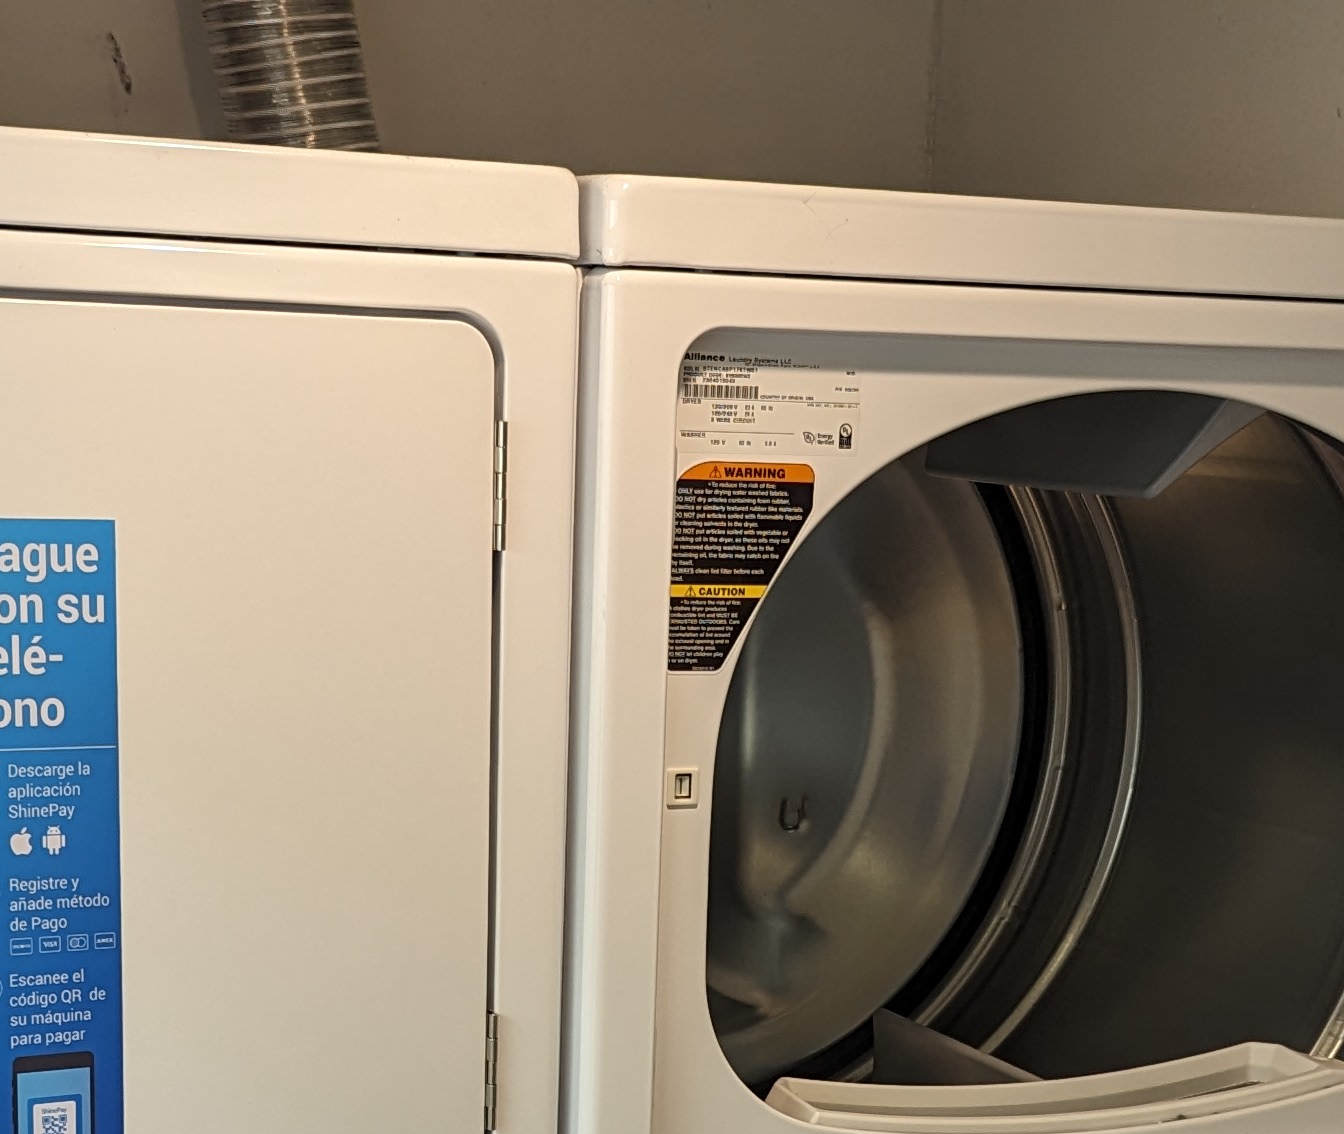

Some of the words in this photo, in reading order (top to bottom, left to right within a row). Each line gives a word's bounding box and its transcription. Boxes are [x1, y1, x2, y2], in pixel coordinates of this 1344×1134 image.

[684, 352, 726, 362] Alliance
[724, 467, 786, 479] WARNING
[698, 587, 746, 596] CAUTION
[57, 592, 105, 623] su
[8, 762, 74, 780] Descarge
[78, 761, 91, 776] la
[8, 781, 81, 800] aplicación
[8, 802, 75, 820] ShinePay
[9, 877, 66, 894] Registre
[70, 878, 79, 892] y
[9, 897, 54, 913] añade
[57, 892, 110, 909] método
[10, 917, 28, 931] de
[31, 917, 67, 932] Pago
[9, 972, 69, 988] Escanee
[73, 968, 84, 984] el
[9, 989, 57, 1010] código
[61, 987, 81, 1004] QR
[89, 986, 106, 1002] de
[10, 1013, 26, 1026] su
[30, 1008, 91, 1028] máquina
[10, 1032, 41, 1048] para
[45, 1028, 86, 1046] pagar
